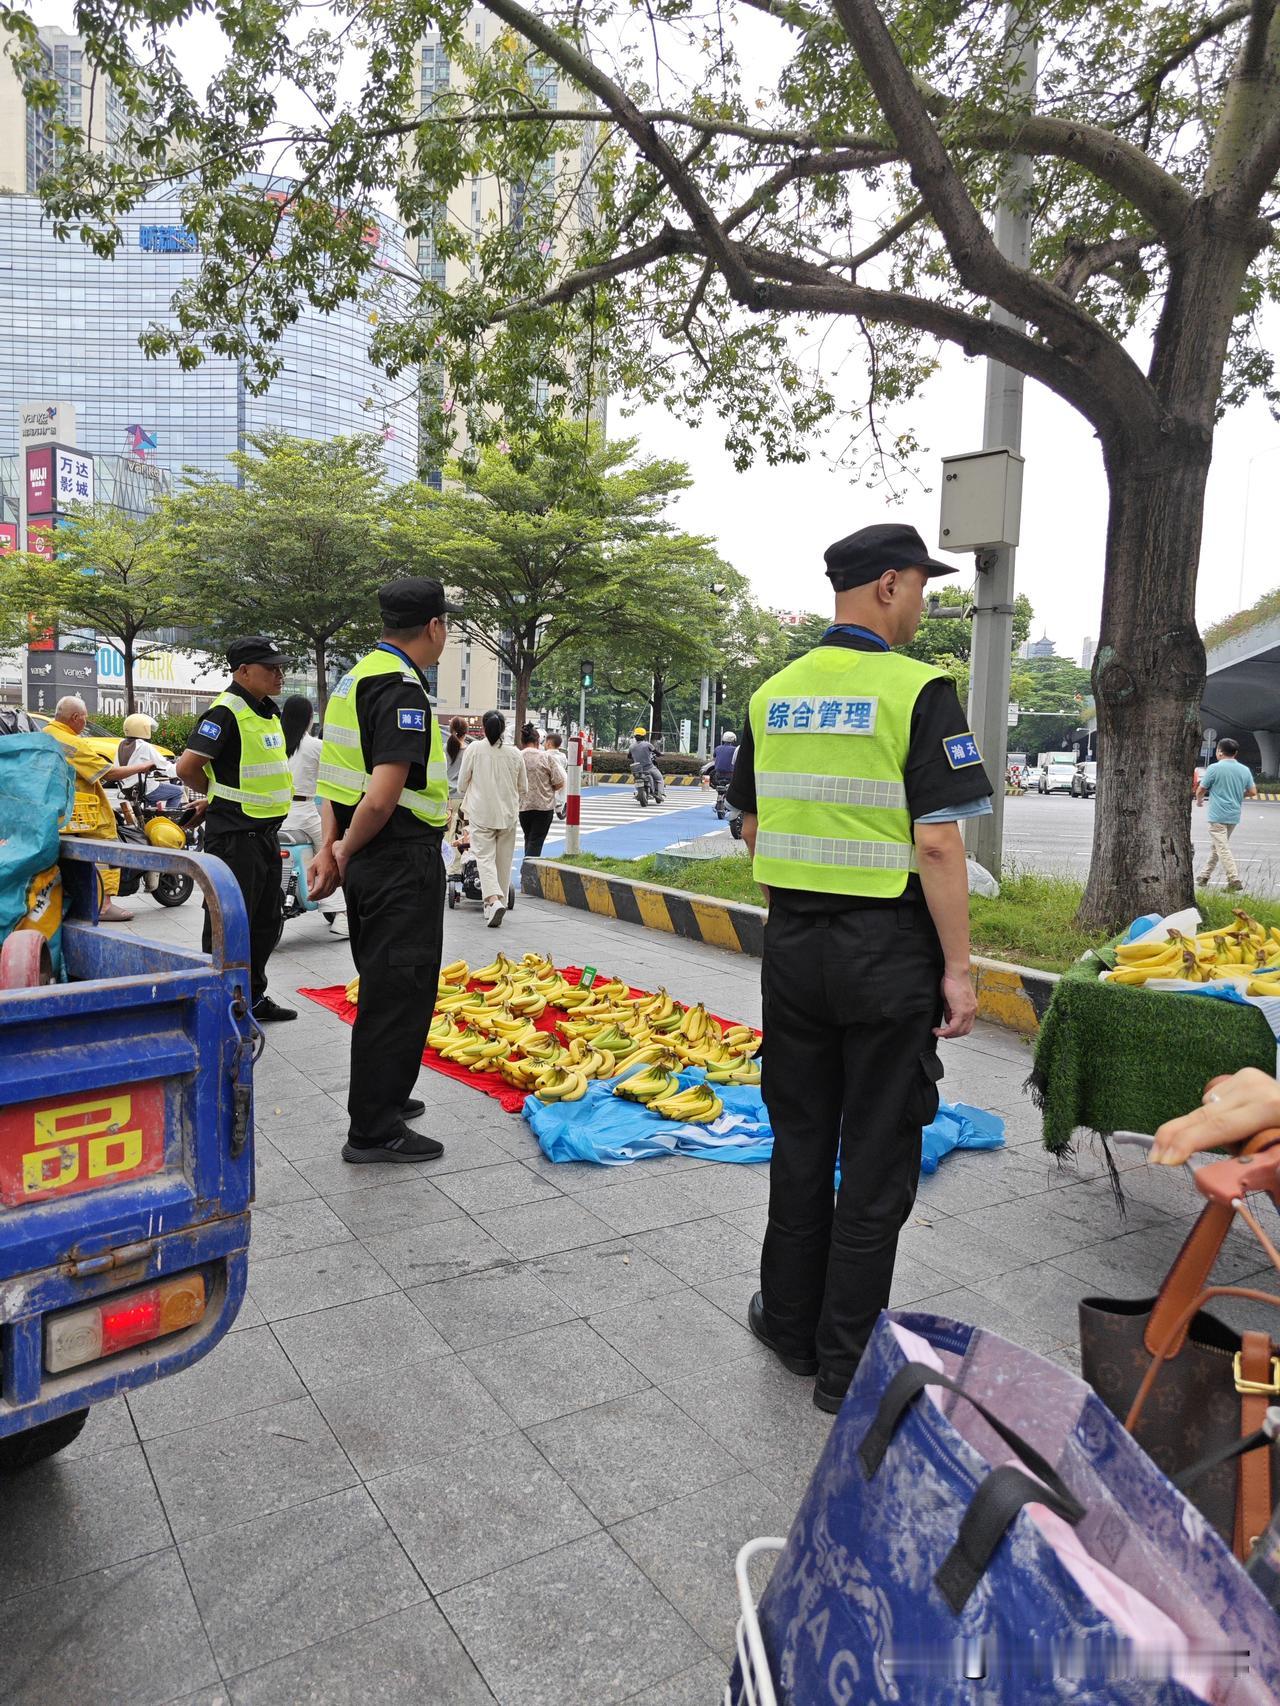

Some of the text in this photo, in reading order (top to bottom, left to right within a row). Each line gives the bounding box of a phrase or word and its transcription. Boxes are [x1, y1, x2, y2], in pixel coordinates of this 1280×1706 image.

[30, 467, 47, 482] MUJI
[60, 456, 89, 479] 万达
[60, 476, 89, 498] 影城
[139, 652, 175, 681] PARK
[767, 700, 872, 730] 综合管理
[22, 1094, 142, 1194] 品
